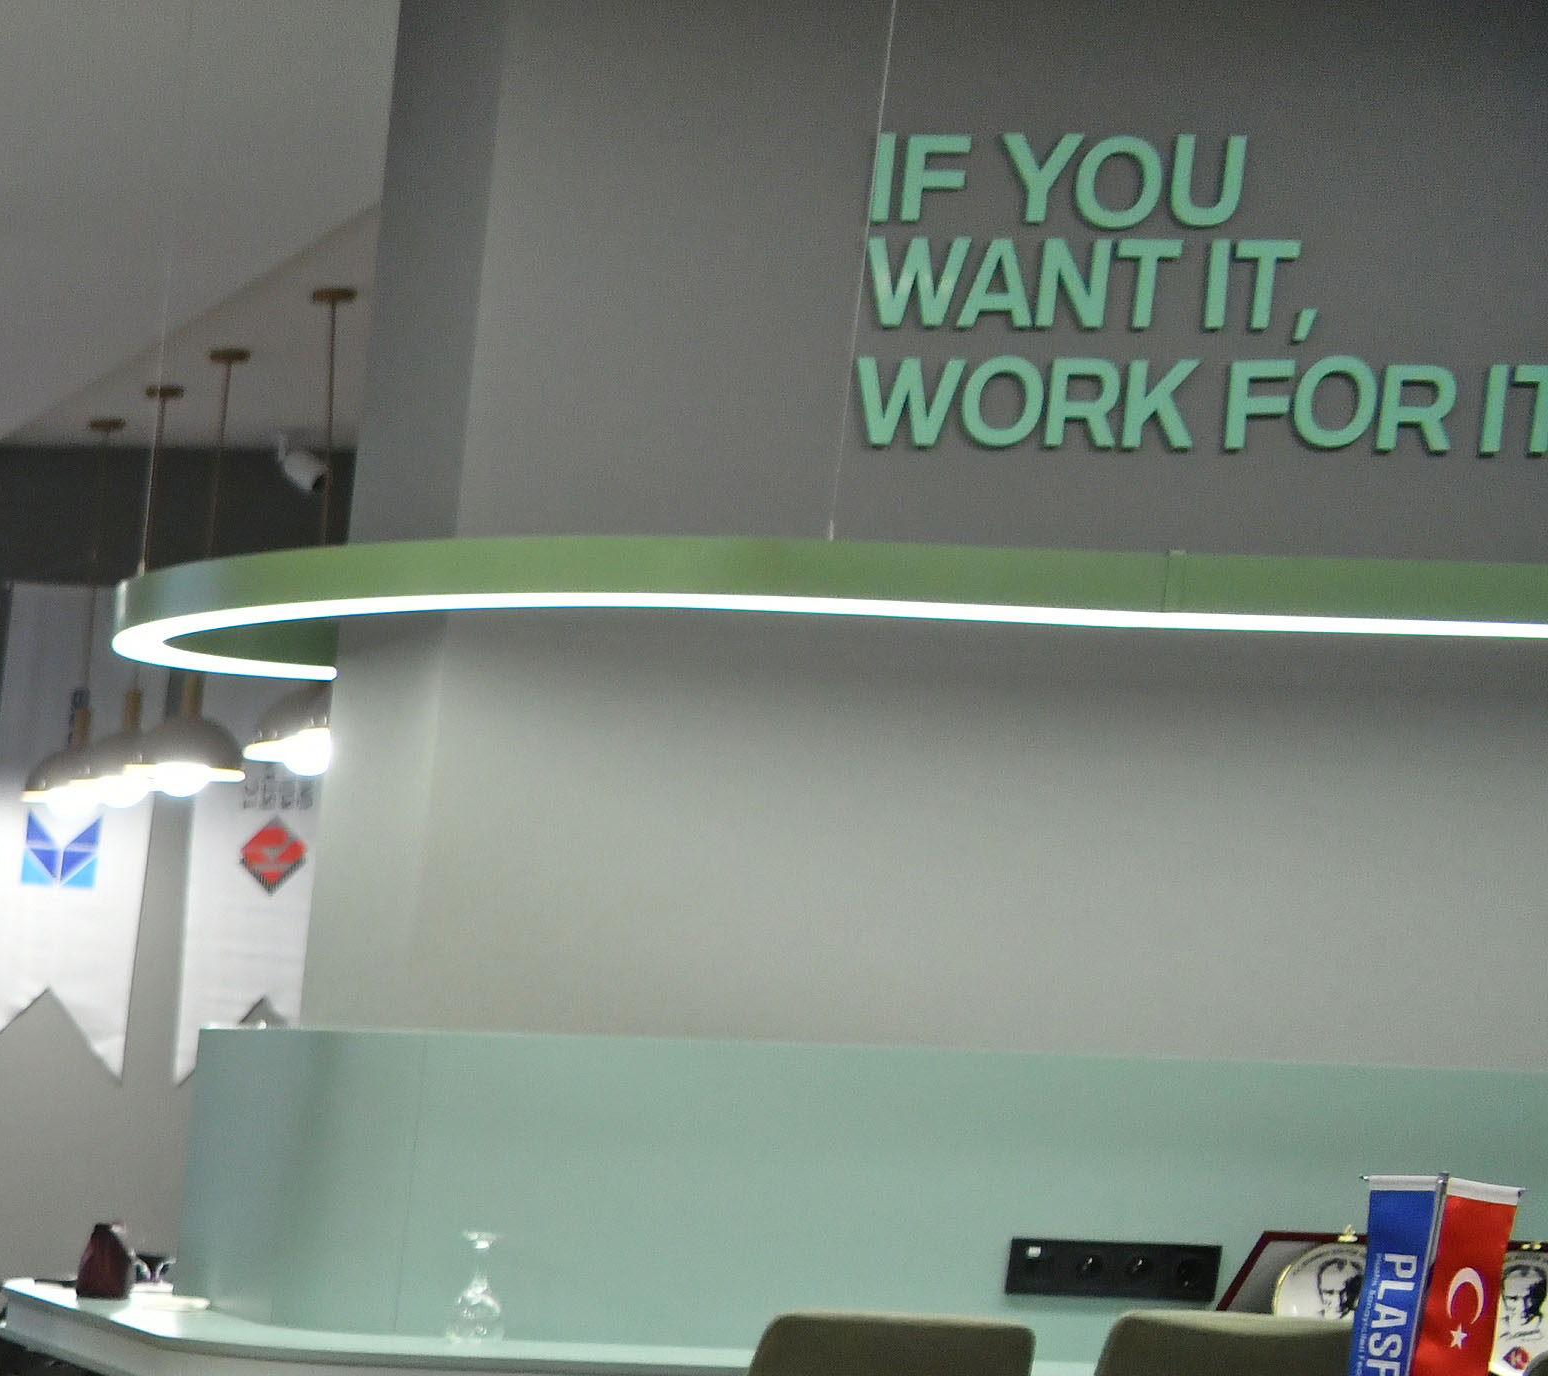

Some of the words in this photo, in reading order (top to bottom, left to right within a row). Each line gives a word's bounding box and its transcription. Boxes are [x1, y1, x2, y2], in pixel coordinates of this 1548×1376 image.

[868, 133, 973, 224] IF
[1002, 133, 1248, 230] YOU
[867, 238, 1184, 330] WANT
[1202, 239, 1318, 343] IT,
[856, 355, 1201, 449] WORK
[1223, 355, 1457, 452] FOR
